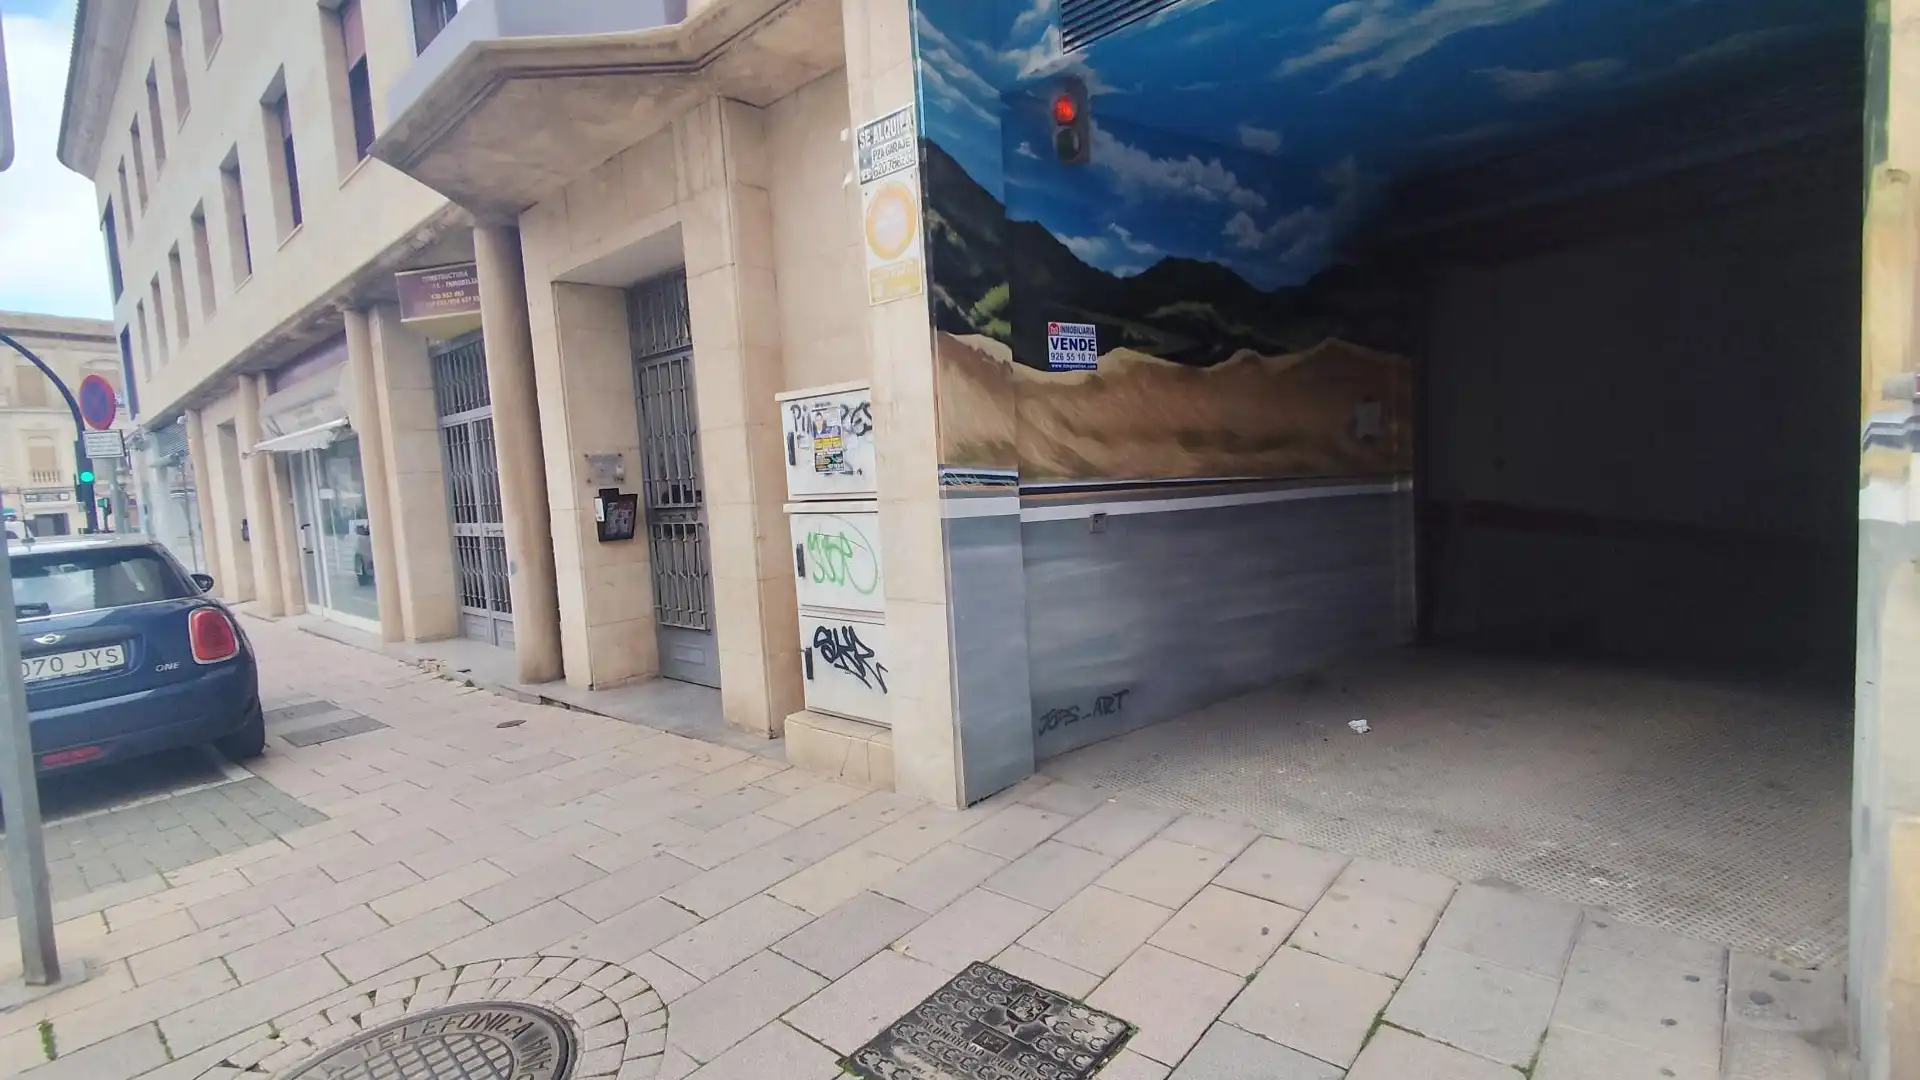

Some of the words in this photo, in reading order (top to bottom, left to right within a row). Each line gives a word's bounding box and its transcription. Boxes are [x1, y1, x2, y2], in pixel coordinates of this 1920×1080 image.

[859, 129, 872, 149] SE
[873, 111, 912, 144] ALQUILA
[886, 138, 911, 156] GARAJE
[1060, 325, 1094, 334] INMOBILIARIA
[1050, 338, 1095, 351] VENDE
[1051, 352, 1064, 361] 926
[1067, 353, 1075, 361] 55
[1078, 353, 1086, 361] 10
[75, 648, 118, 669] JYS
[155, 662, 181, 672] ONE
[354, 1012, 534, 1056] TELEFONICA
